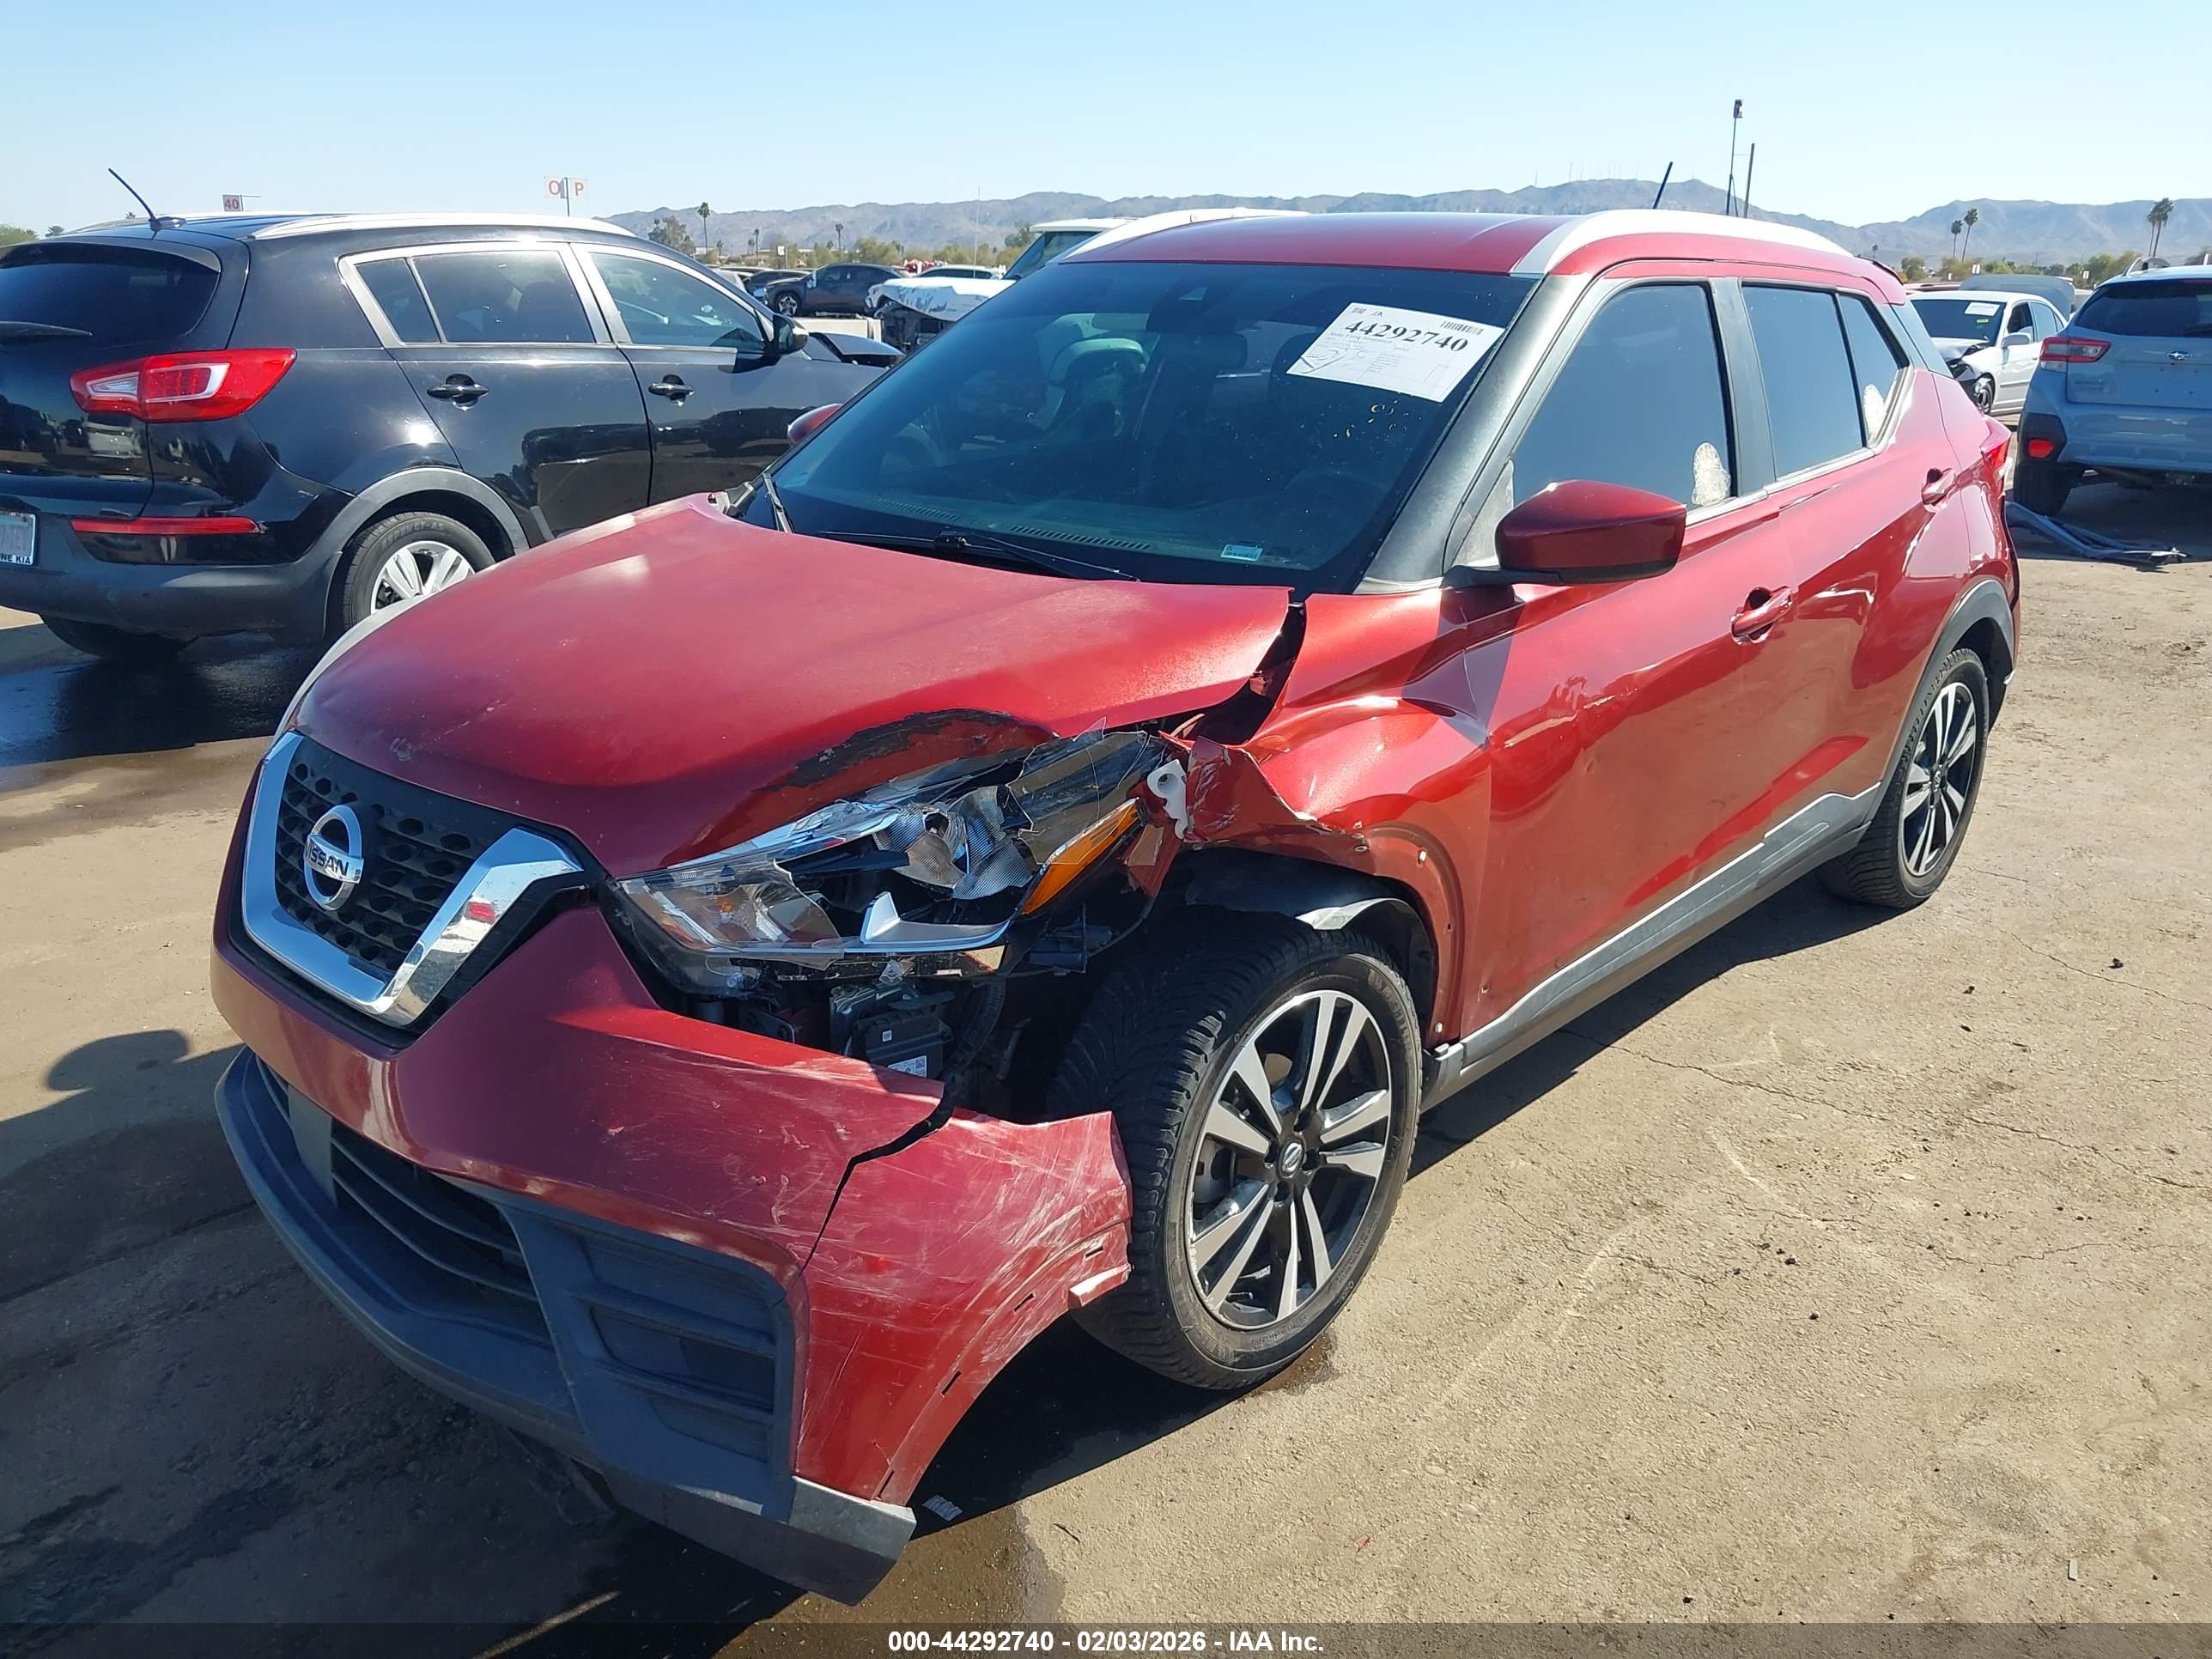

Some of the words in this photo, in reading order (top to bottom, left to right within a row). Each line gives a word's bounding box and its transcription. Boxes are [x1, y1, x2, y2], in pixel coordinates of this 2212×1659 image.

[574, 182, 585, 196] P
[224, 198, 240, 210] 40
[1345, 320, 1468, 352] 44292740
[15, 556, 31, 564] KIA
